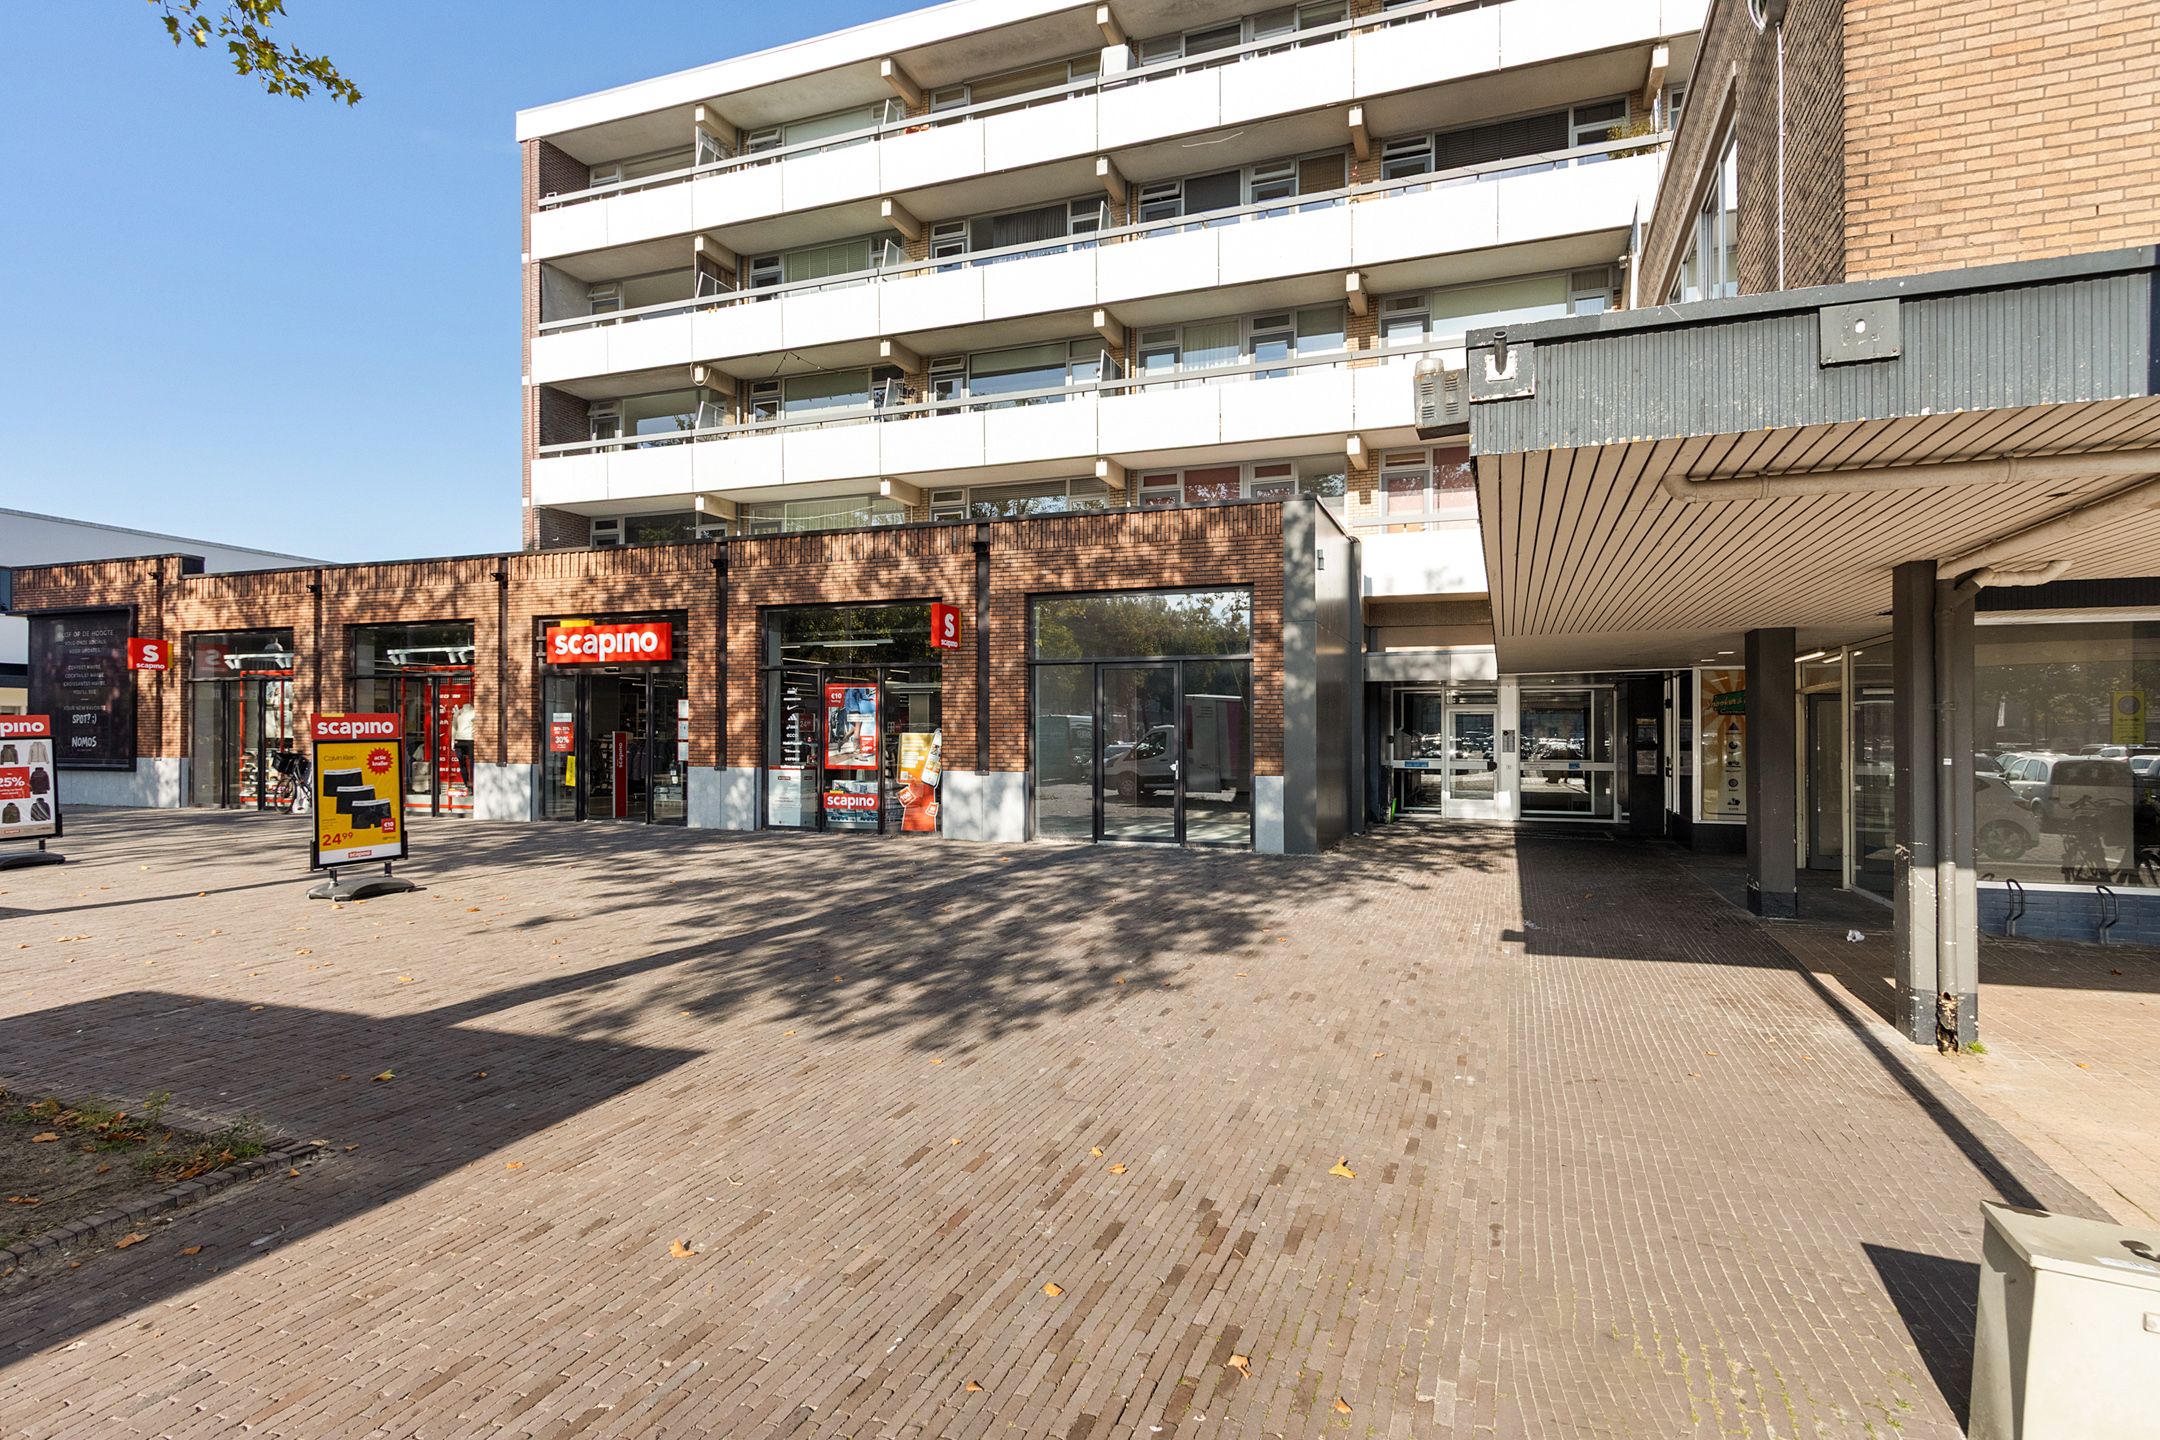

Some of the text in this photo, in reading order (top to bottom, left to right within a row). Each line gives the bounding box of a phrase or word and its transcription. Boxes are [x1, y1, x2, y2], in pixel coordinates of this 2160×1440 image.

[944, 613, 955, 638] S
[142, 644, 160, 663] S
[554, 631, 658, 662] scapino
[72, 713, 91, 724] SPOT?
[0, 721, 45, 737] pino
[317, 721, 394, 739] scapino
[71, 736, 97, 748] NOMOS
[827, 795, 875, 809] scapino
